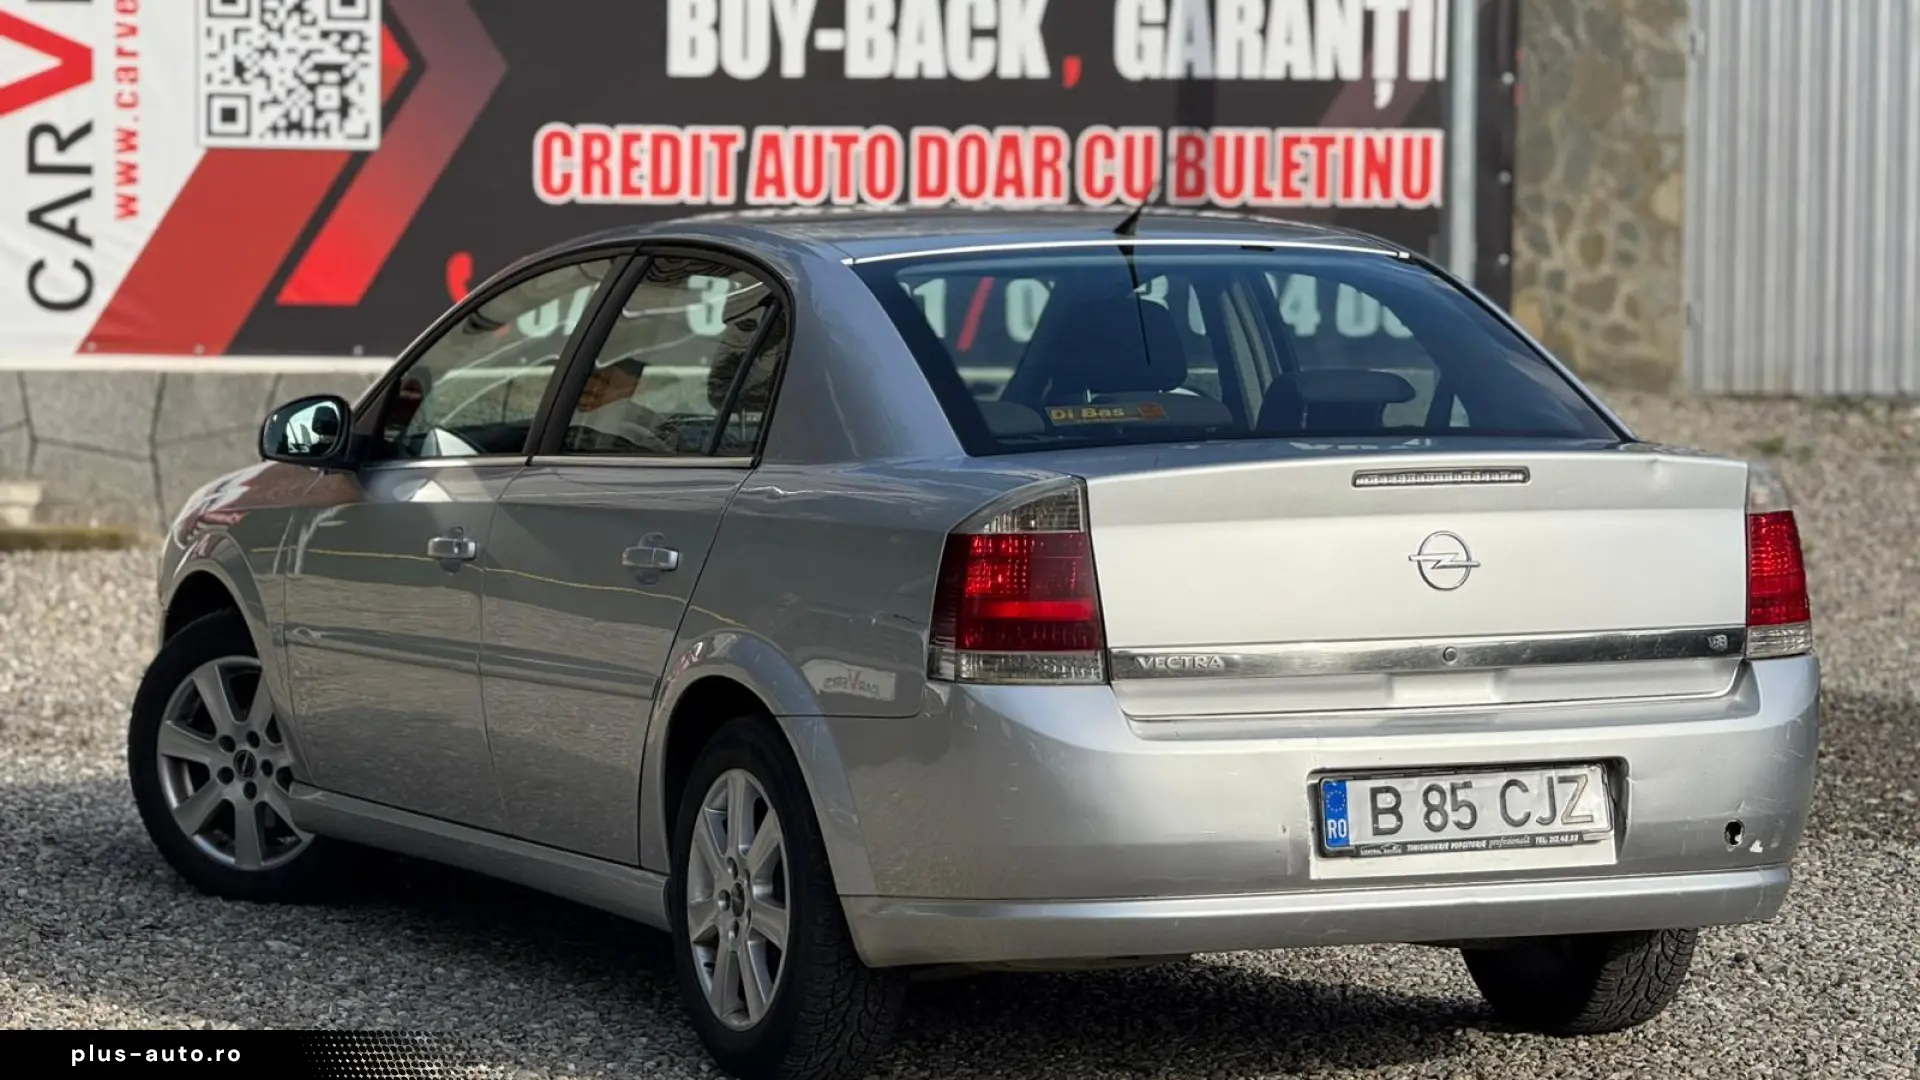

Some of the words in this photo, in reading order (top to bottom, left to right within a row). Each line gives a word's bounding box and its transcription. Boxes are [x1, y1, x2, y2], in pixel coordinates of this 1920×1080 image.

[666, 0, 1050, 80] BUY-BACK
[534, 123, 745, 204] CREDIT
[747, 125, 903, 205] AUTO
[910, 126, 1070, 205] DOAR
[1075, 125, 1162, 206] CU
[1136, 655, 1224, 671] VECTRA
[1327, 820, 1347, 839] RO
[1370, 786, 1403, 836] B
[1421, 780, 1478, 832] 85
[1499, 773, 1595, 828] CJZ
